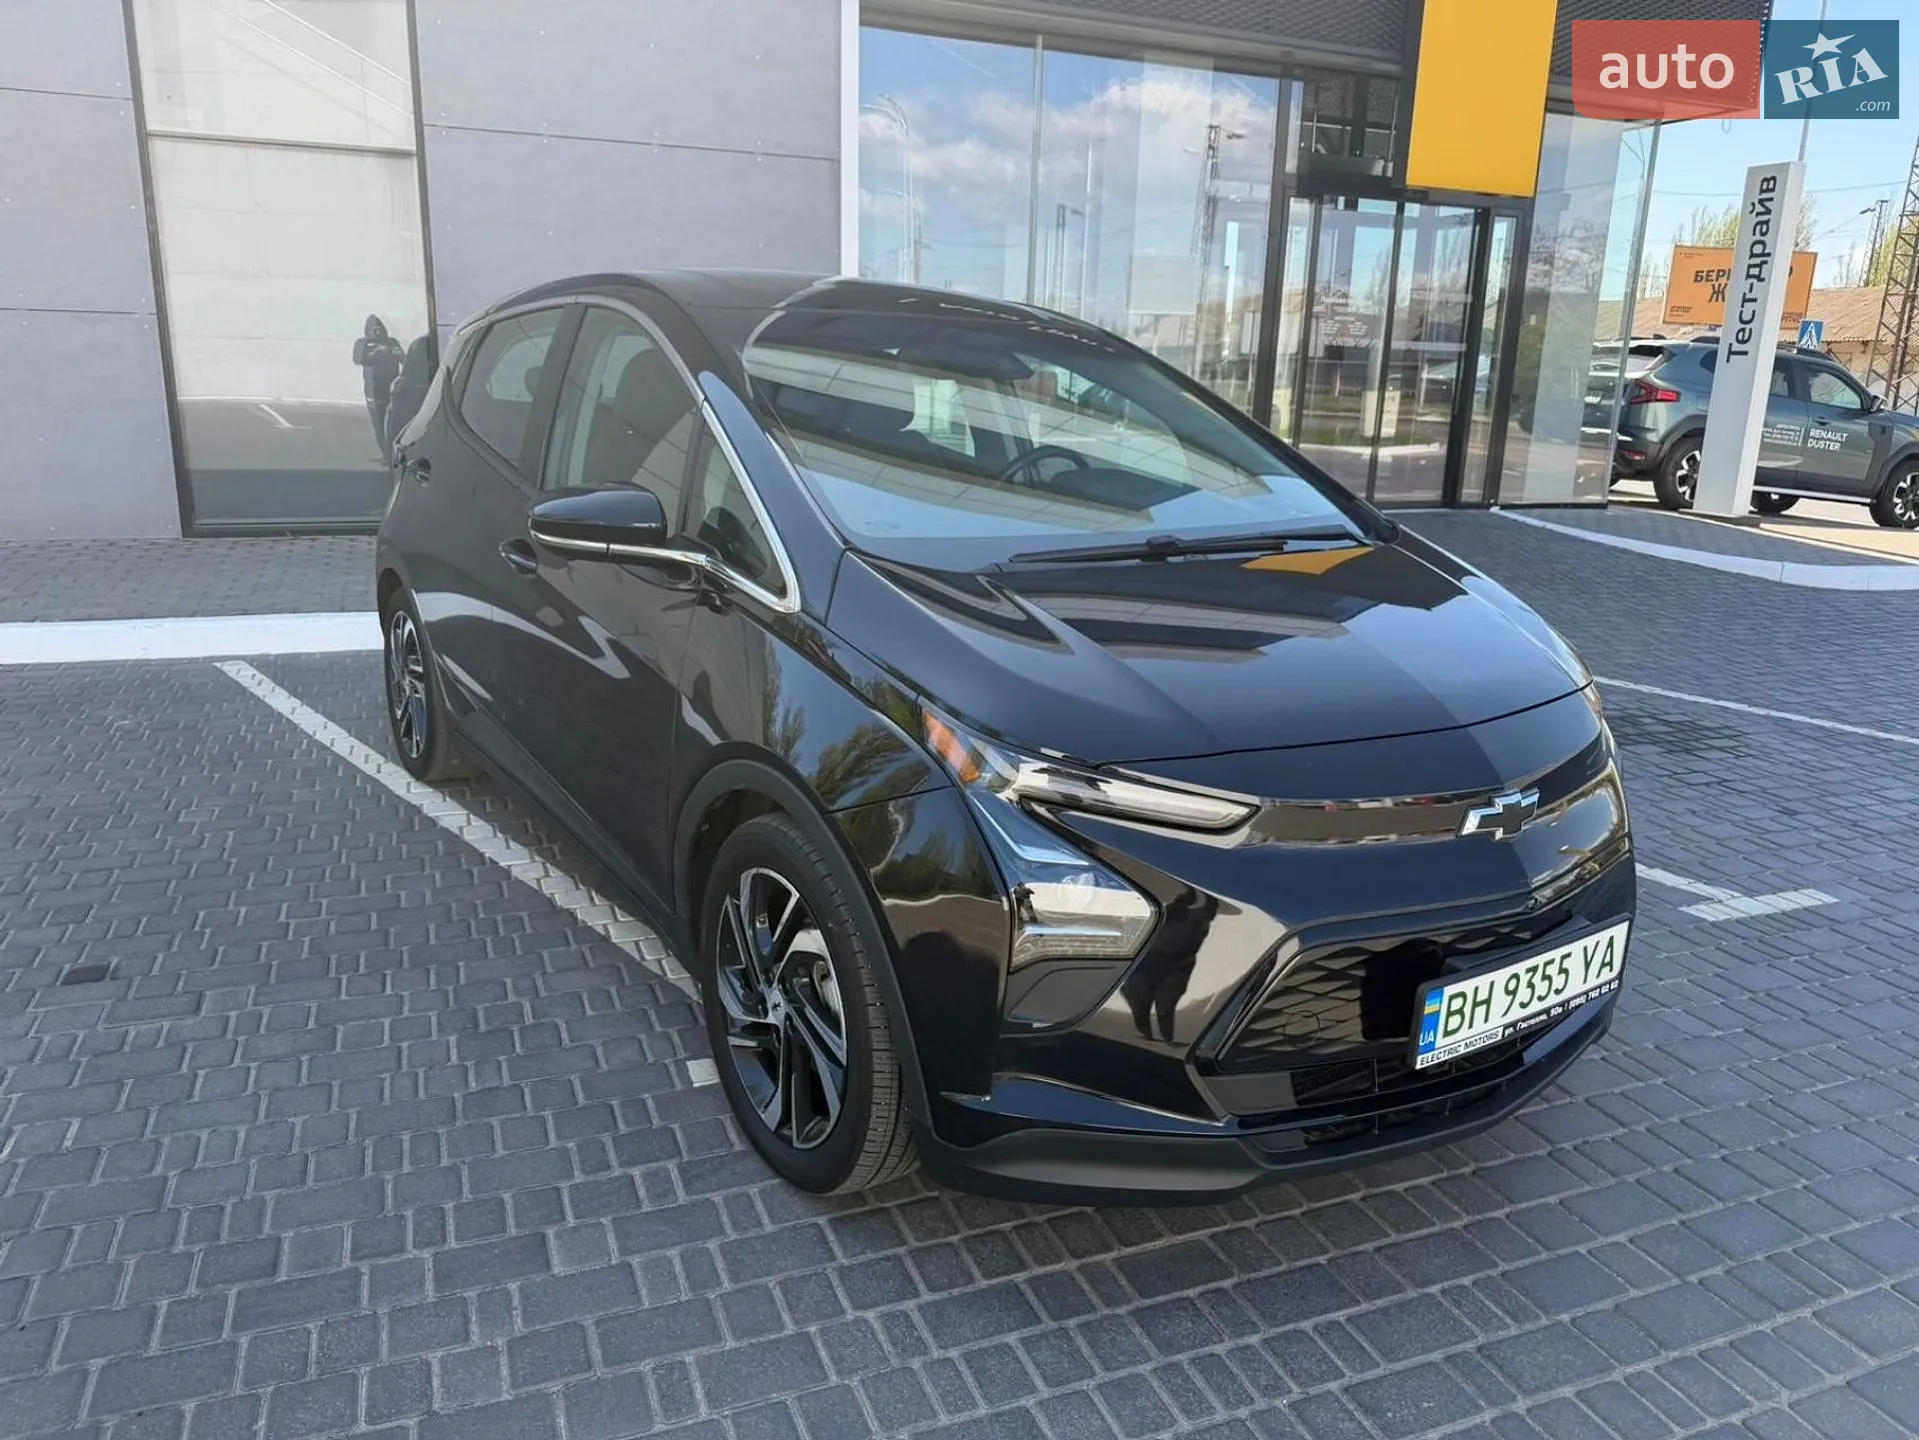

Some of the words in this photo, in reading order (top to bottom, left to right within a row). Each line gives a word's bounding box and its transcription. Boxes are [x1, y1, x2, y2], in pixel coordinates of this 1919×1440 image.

[1726, 175, 1777, 363] Тест-драйв
[1807, 439, 1841, 451] DUSTER
[1809, 428, 1848, 442] RENAULT
[1443, 980, 1495, 1038] BH
[1501, 952, 1572, 1017] 9355
[1583, 936, 1615, 984] YA
[1419, 1030, 1435, 1045] UA
[1420, 1044, 1461, 1065] ELECTRIC
[1463, 1030, 1500, 1052] MOTORS
